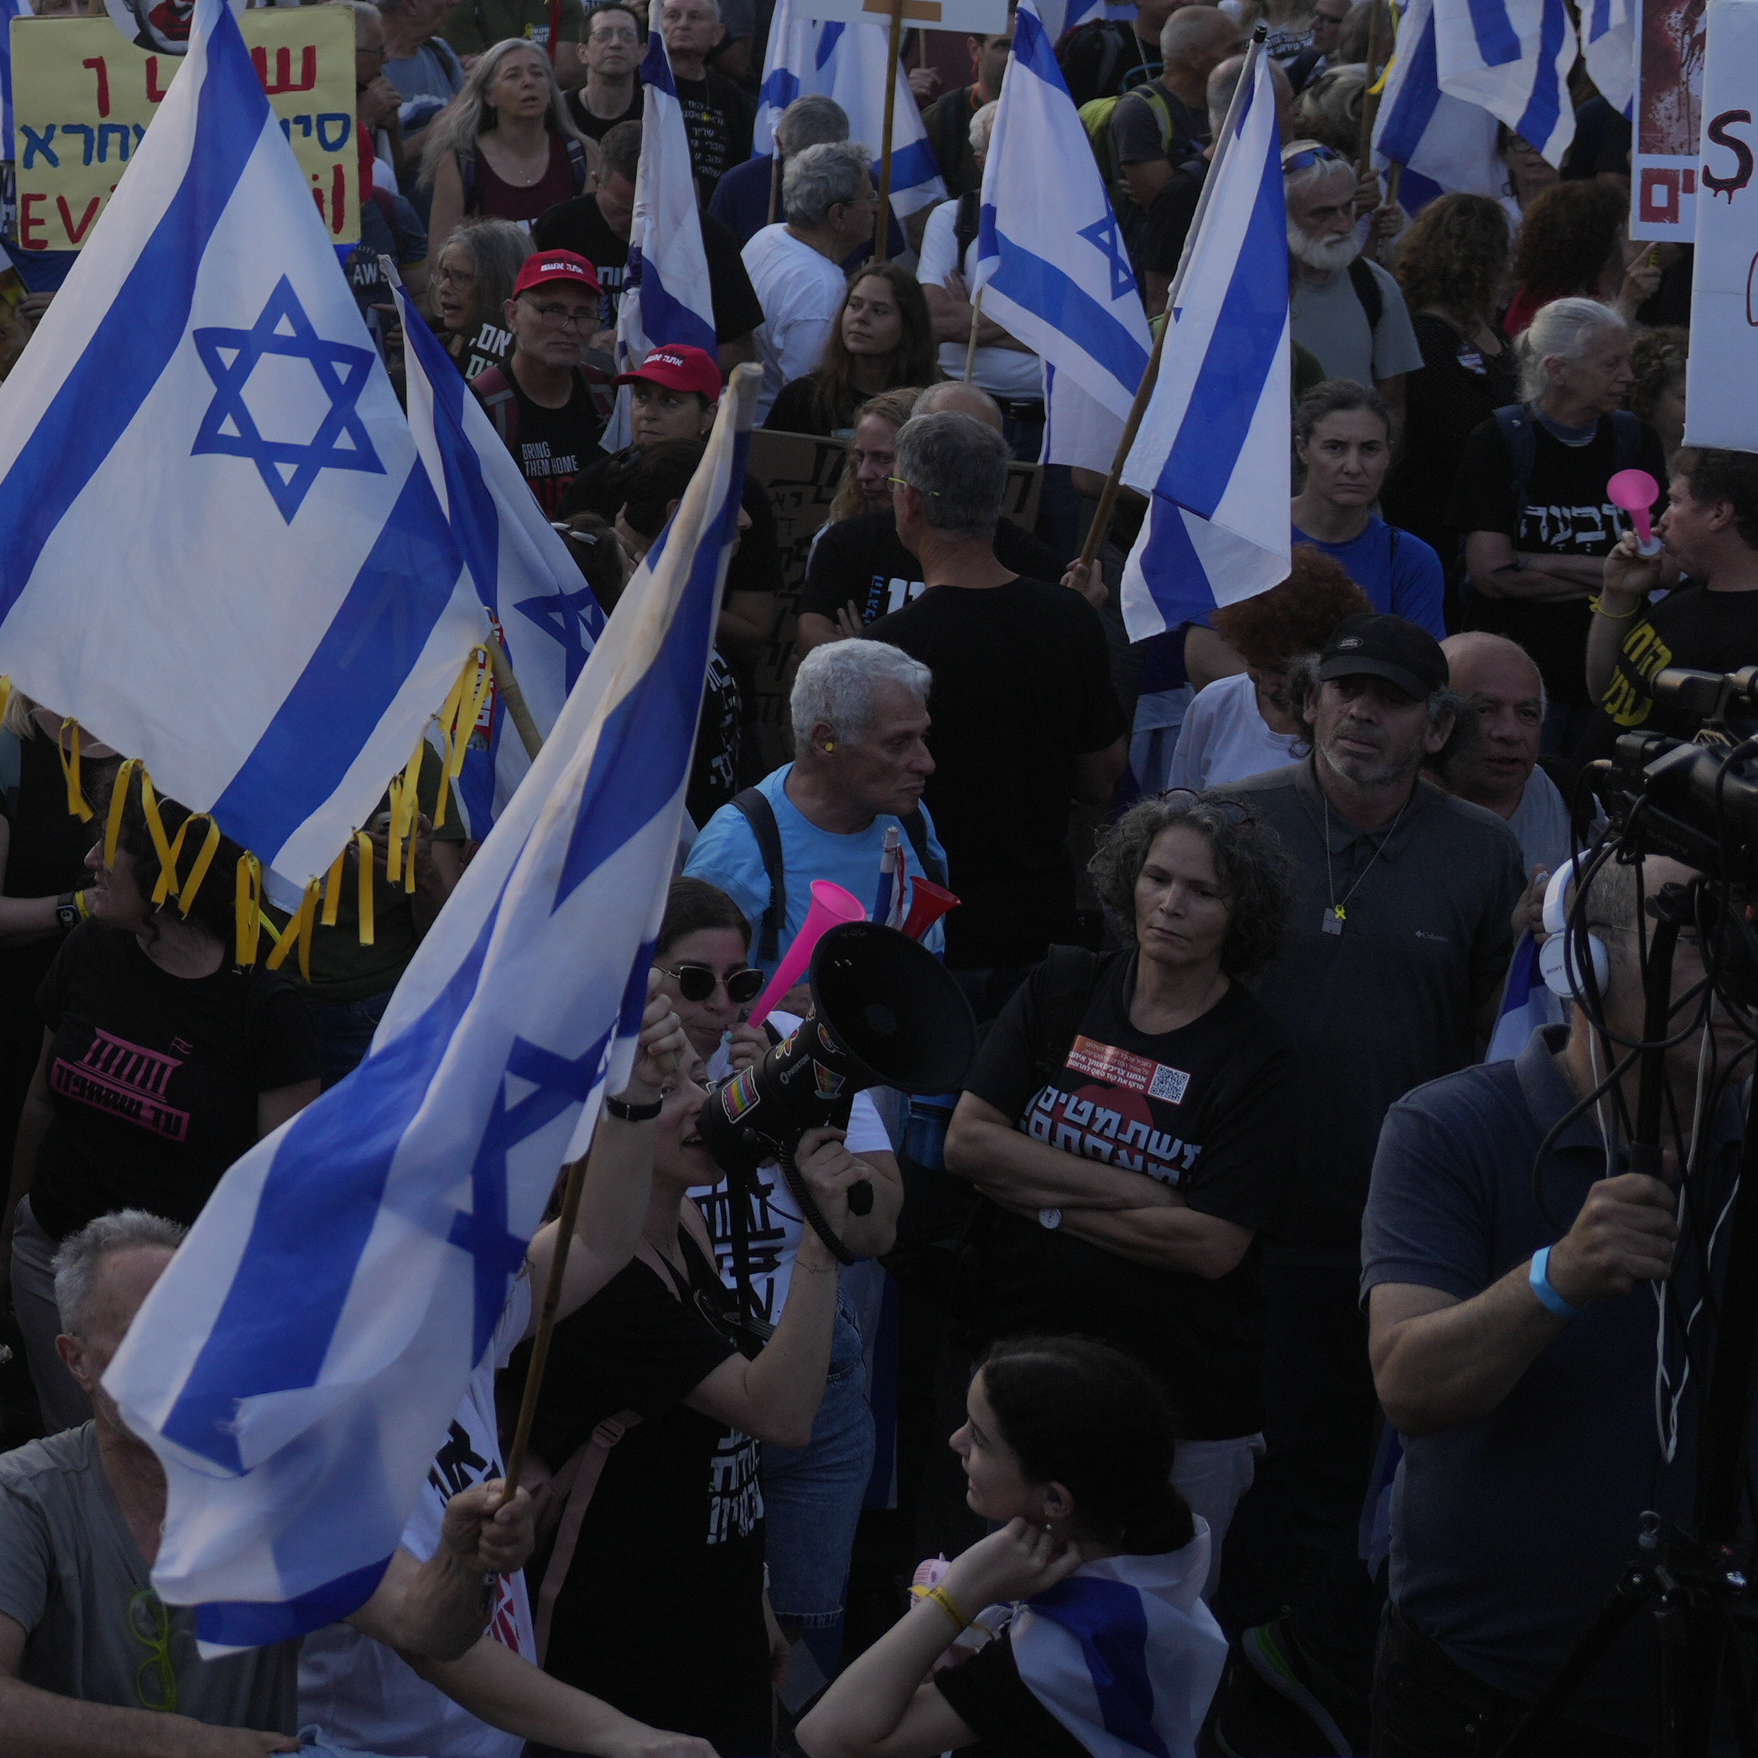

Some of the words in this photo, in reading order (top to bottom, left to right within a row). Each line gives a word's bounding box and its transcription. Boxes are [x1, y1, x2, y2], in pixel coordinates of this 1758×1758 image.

[522, 441, 550, 460] BRING
[524, 458, 551, 477] THEM
[552, 455, 579, 473] HOME
[1117, 1076, 1128, 1084] את
[1125, 1071, 1146, 1082] אנחנו
